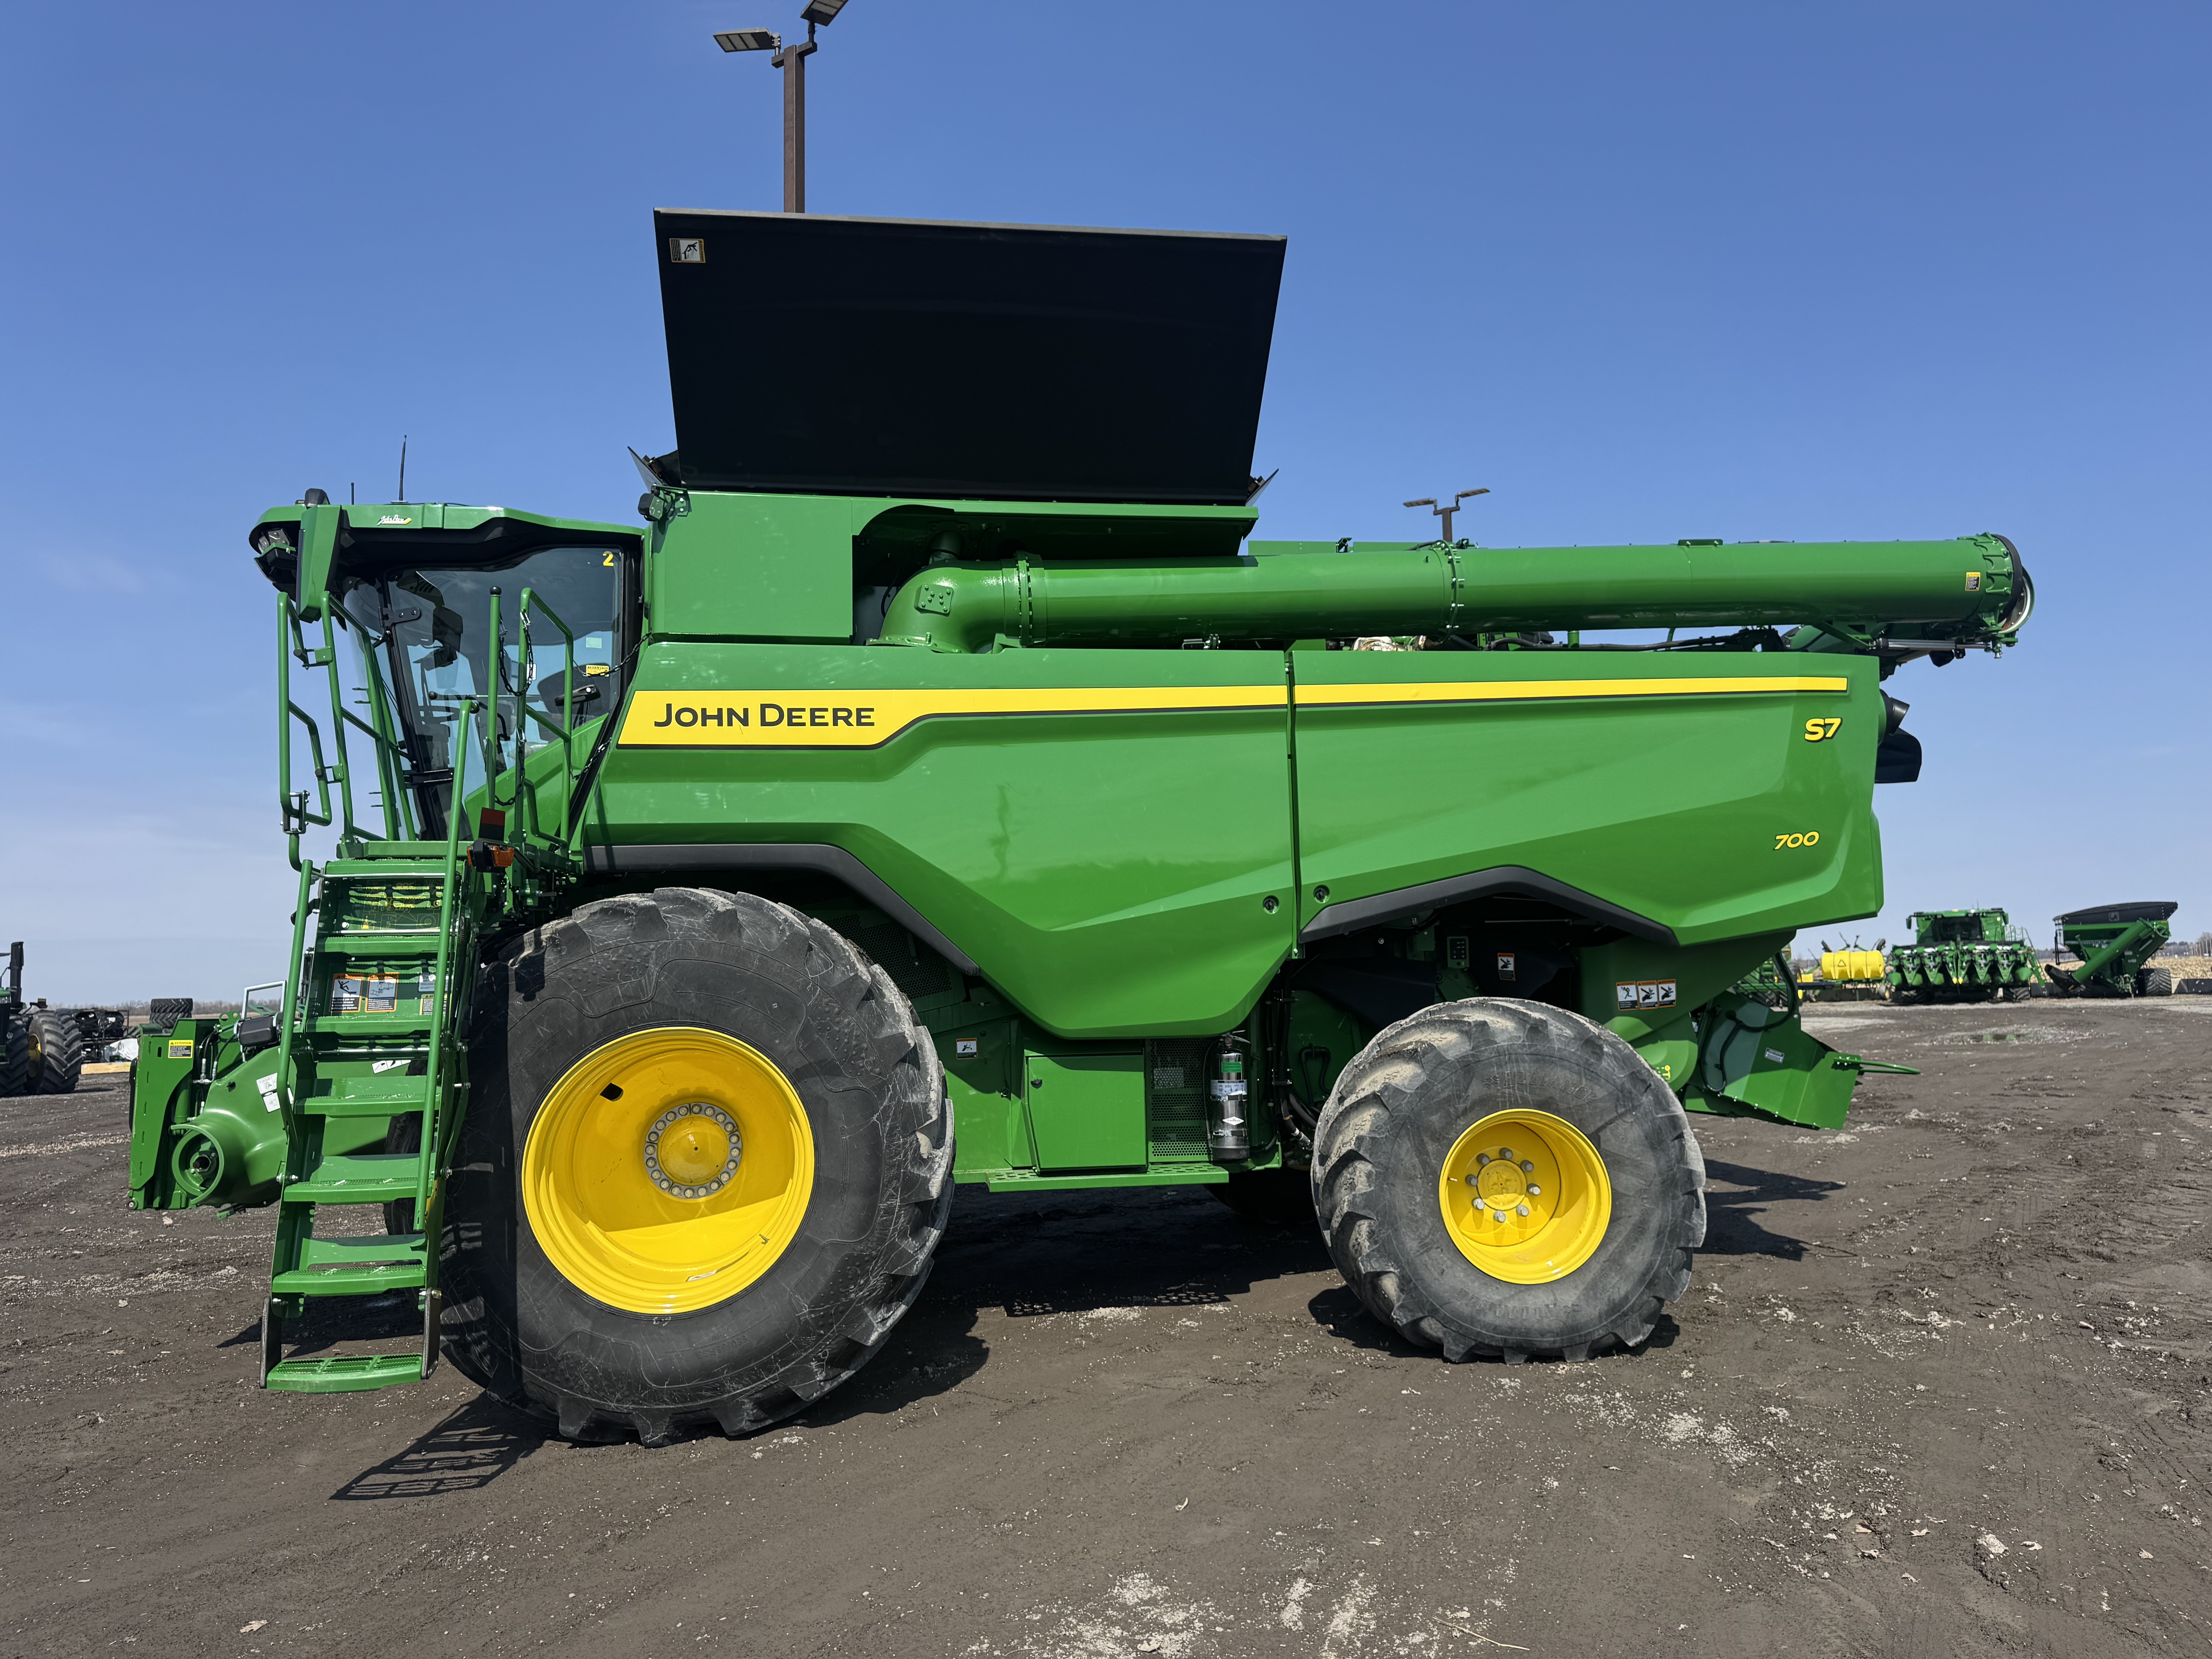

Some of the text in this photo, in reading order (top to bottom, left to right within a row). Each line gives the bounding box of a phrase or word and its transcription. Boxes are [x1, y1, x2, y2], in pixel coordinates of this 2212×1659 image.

[603, 551, 614, 566] 2
[654, 703, 875, 727] JOHN DEERE
[1805, 718, 1841, 741] S7
[1774, 831, 1819, 850] 700
